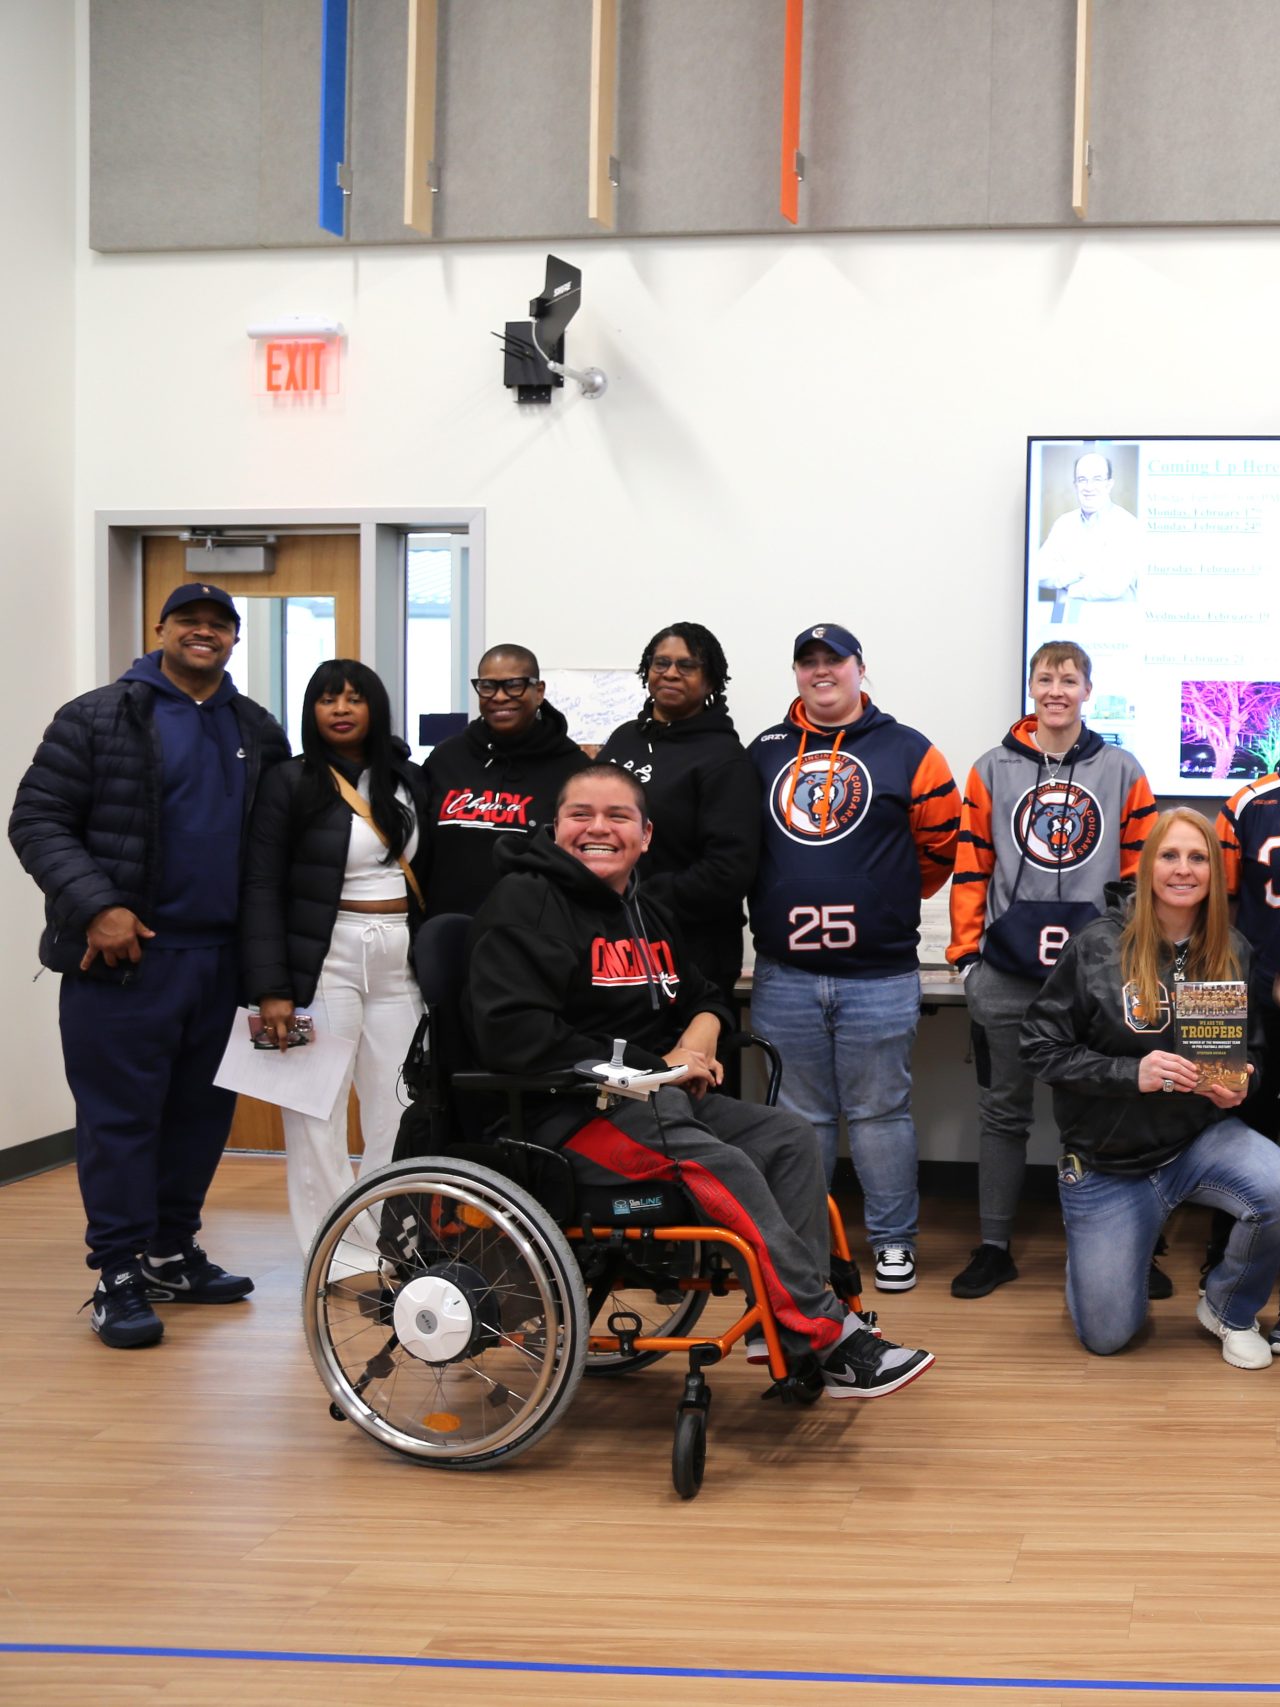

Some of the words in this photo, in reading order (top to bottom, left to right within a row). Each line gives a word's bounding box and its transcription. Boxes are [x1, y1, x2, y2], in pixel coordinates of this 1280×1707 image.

[266, 342, 326, 392] EXIT
[1147, 459, 1209, 477] Coming
[1243, 459, 1280, 474] Here
[840, 775, 862, 824] COUGARS
[1075, 809, 1097, 855] COUGARS
[787, 904, 857, 952] 25
[1180, 1025, 1243, 1039] TROOPERS
